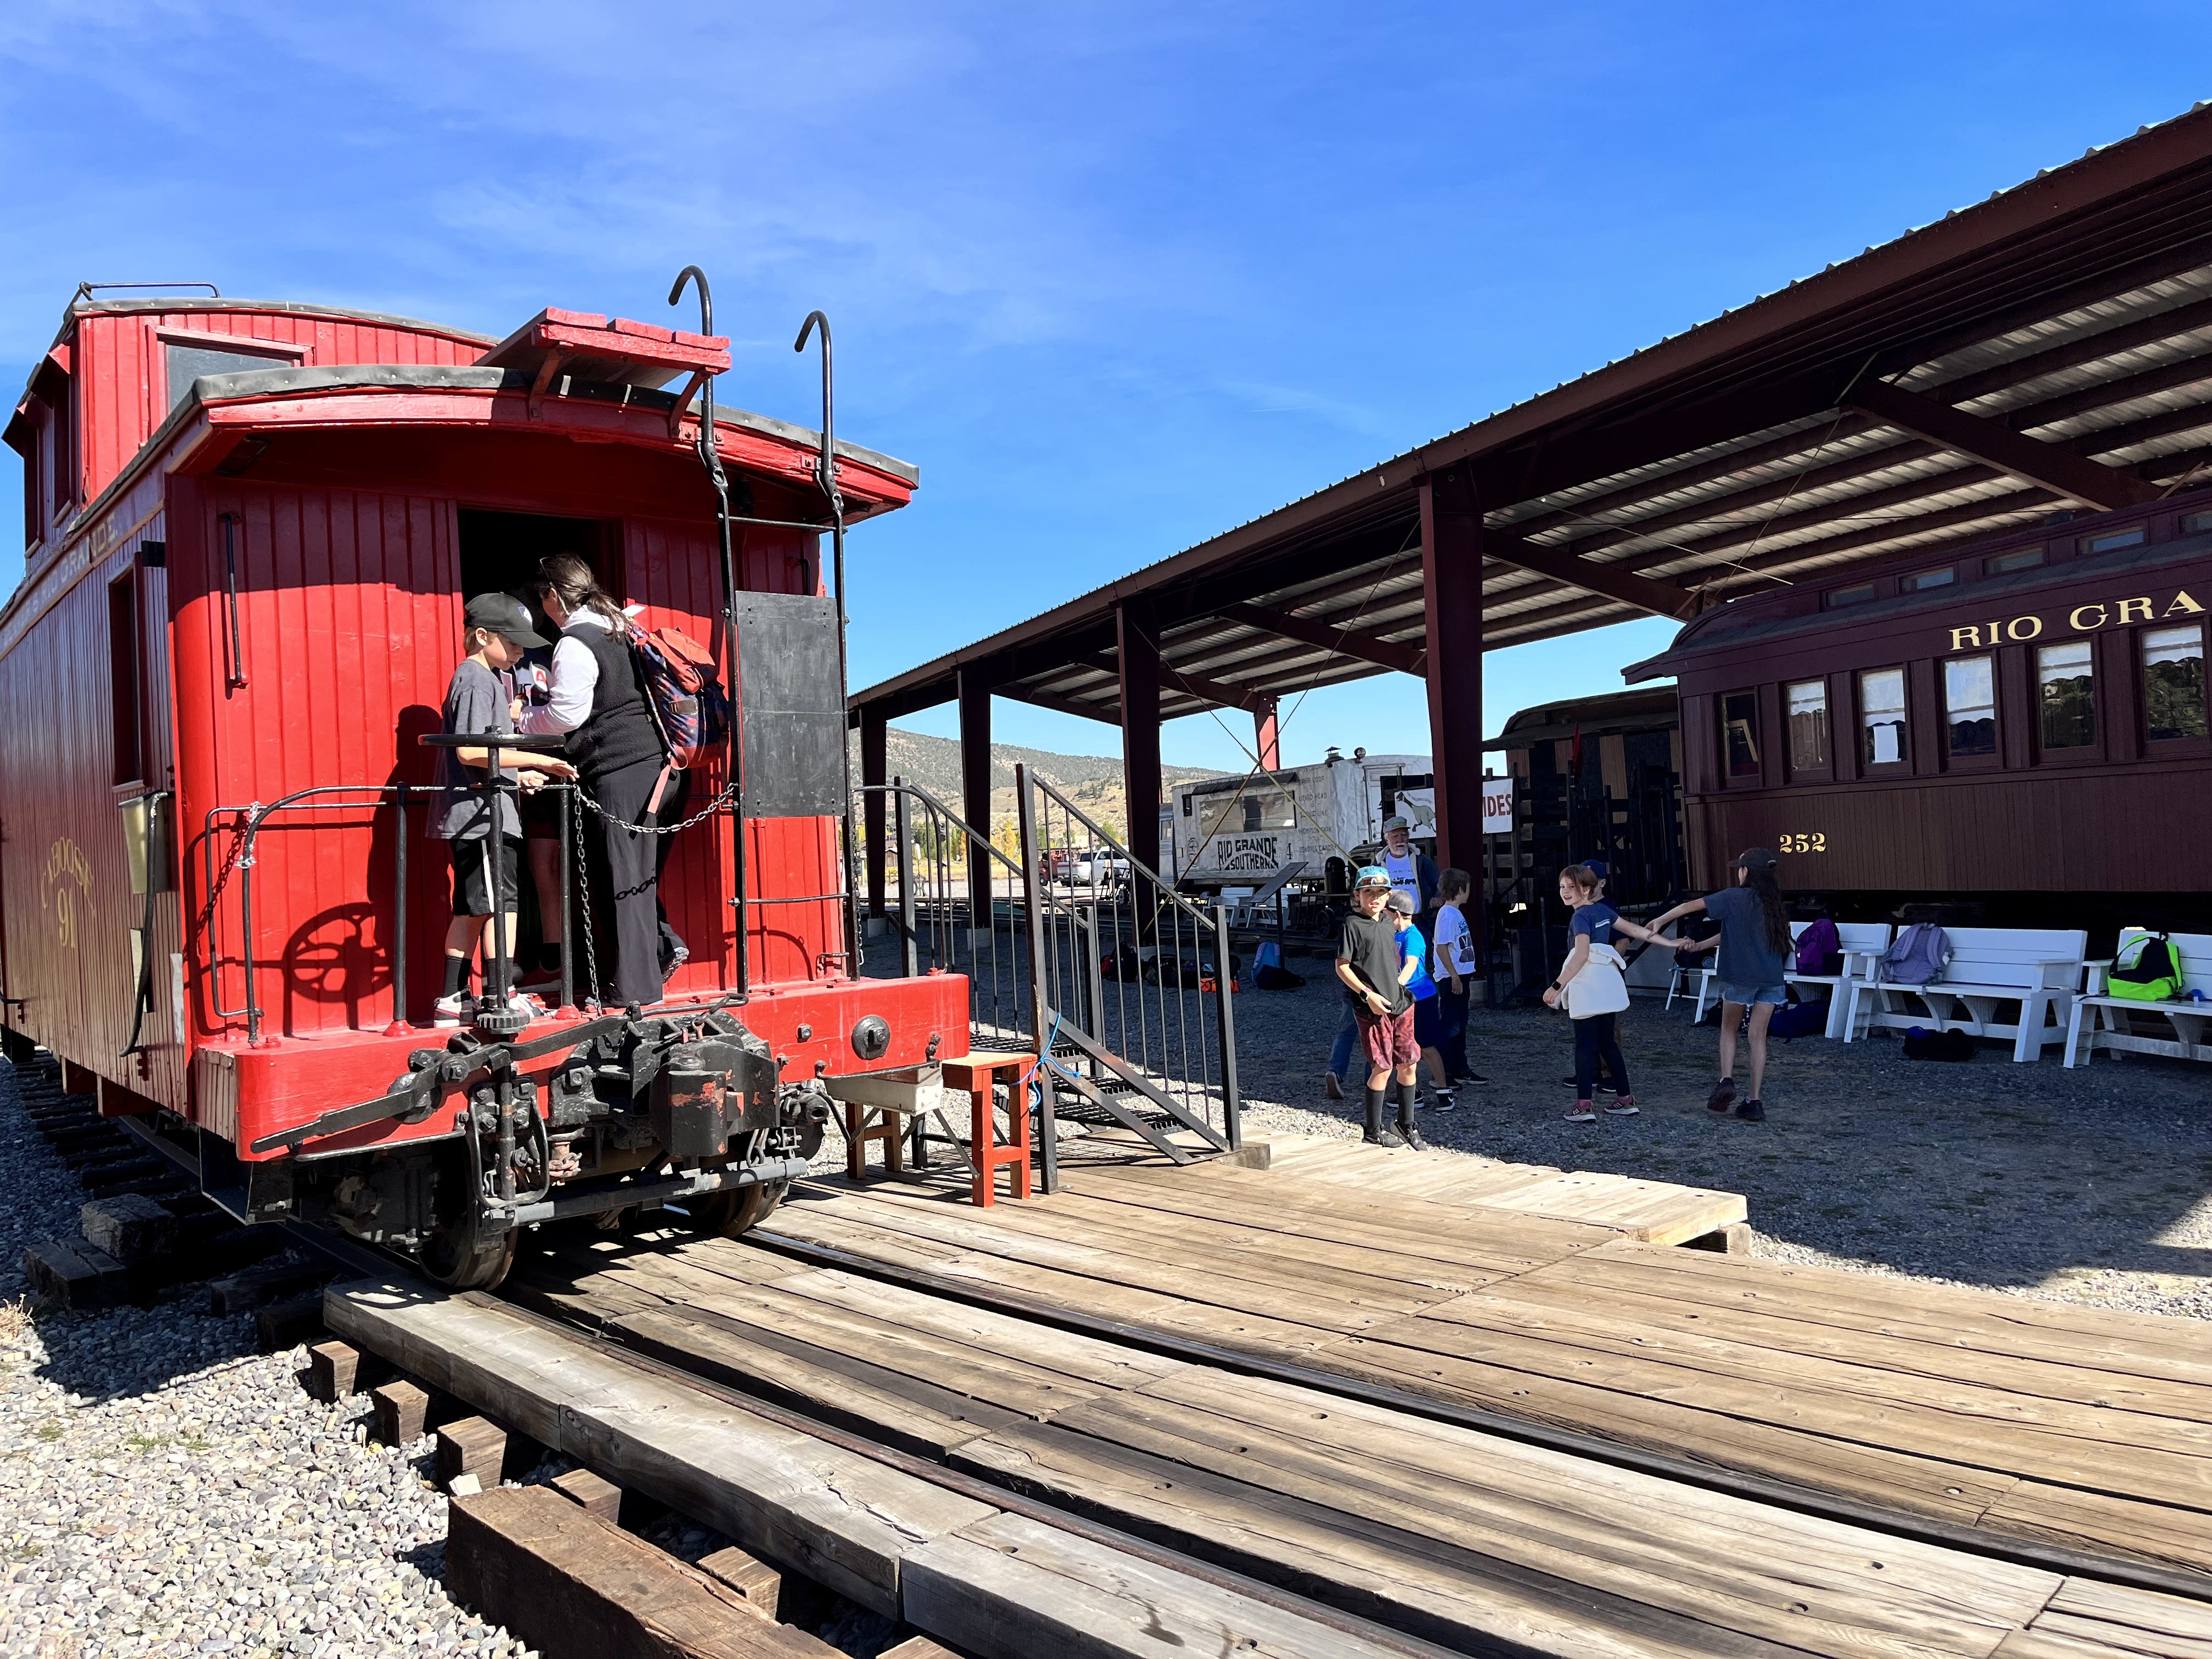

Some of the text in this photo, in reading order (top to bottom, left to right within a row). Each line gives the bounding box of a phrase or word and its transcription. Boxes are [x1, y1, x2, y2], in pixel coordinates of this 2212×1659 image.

[1949, 590, 2207, 651] RIO GRA
[1217, 840, 1232, 871] RIO
[1235, 837, 1279, 870] GRANDE
[1286, 843, 1293, 859] 4
[1780, 832, 1826, 854] 252
[41, 837, 97, 918] CABOOSE
[1230, 853, 1271, 870] SOUTHERN
[58, 888, 76, 949] 91
